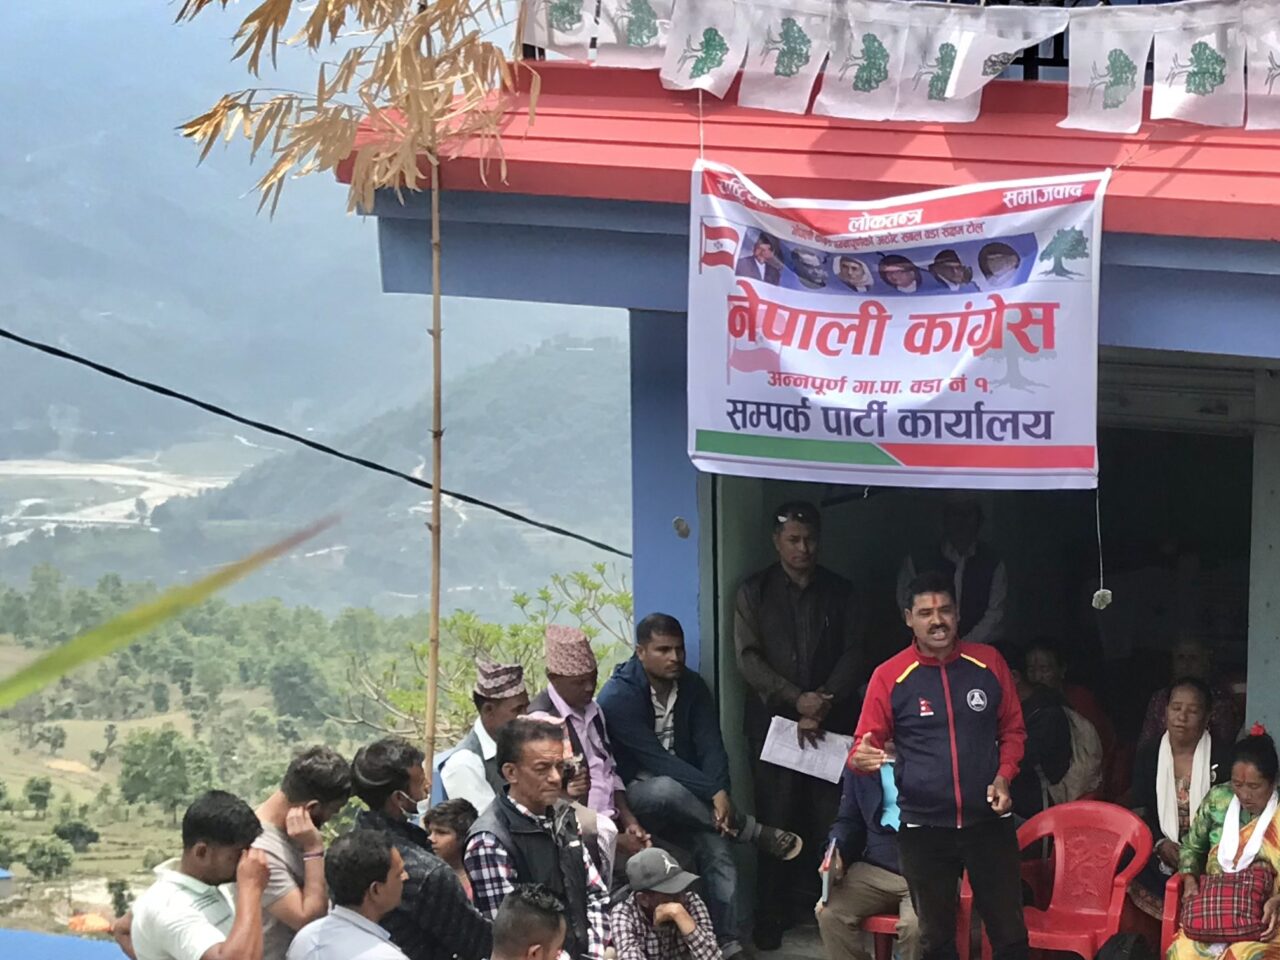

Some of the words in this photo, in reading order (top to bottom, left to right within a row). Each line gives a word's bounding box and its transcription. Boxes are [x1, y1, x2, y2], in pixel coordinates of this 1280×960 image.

[1002, 183, 1085, 209] समाजवाद
[848, 208, 924, 233] लोकतन्त्र
[726, 279, 893, 357] नेपाली
[903, 294, 1061, 358] कांग्रेस
[767, 370, 848, 396] अन्नपूर्ण
[910, 377, 942, 394] वडा
[726, 396, 812, 433] सम्पर्क
[821, 399, 889, 439] पार्टी
[898, 400, 1056, 441] कार्यालय
